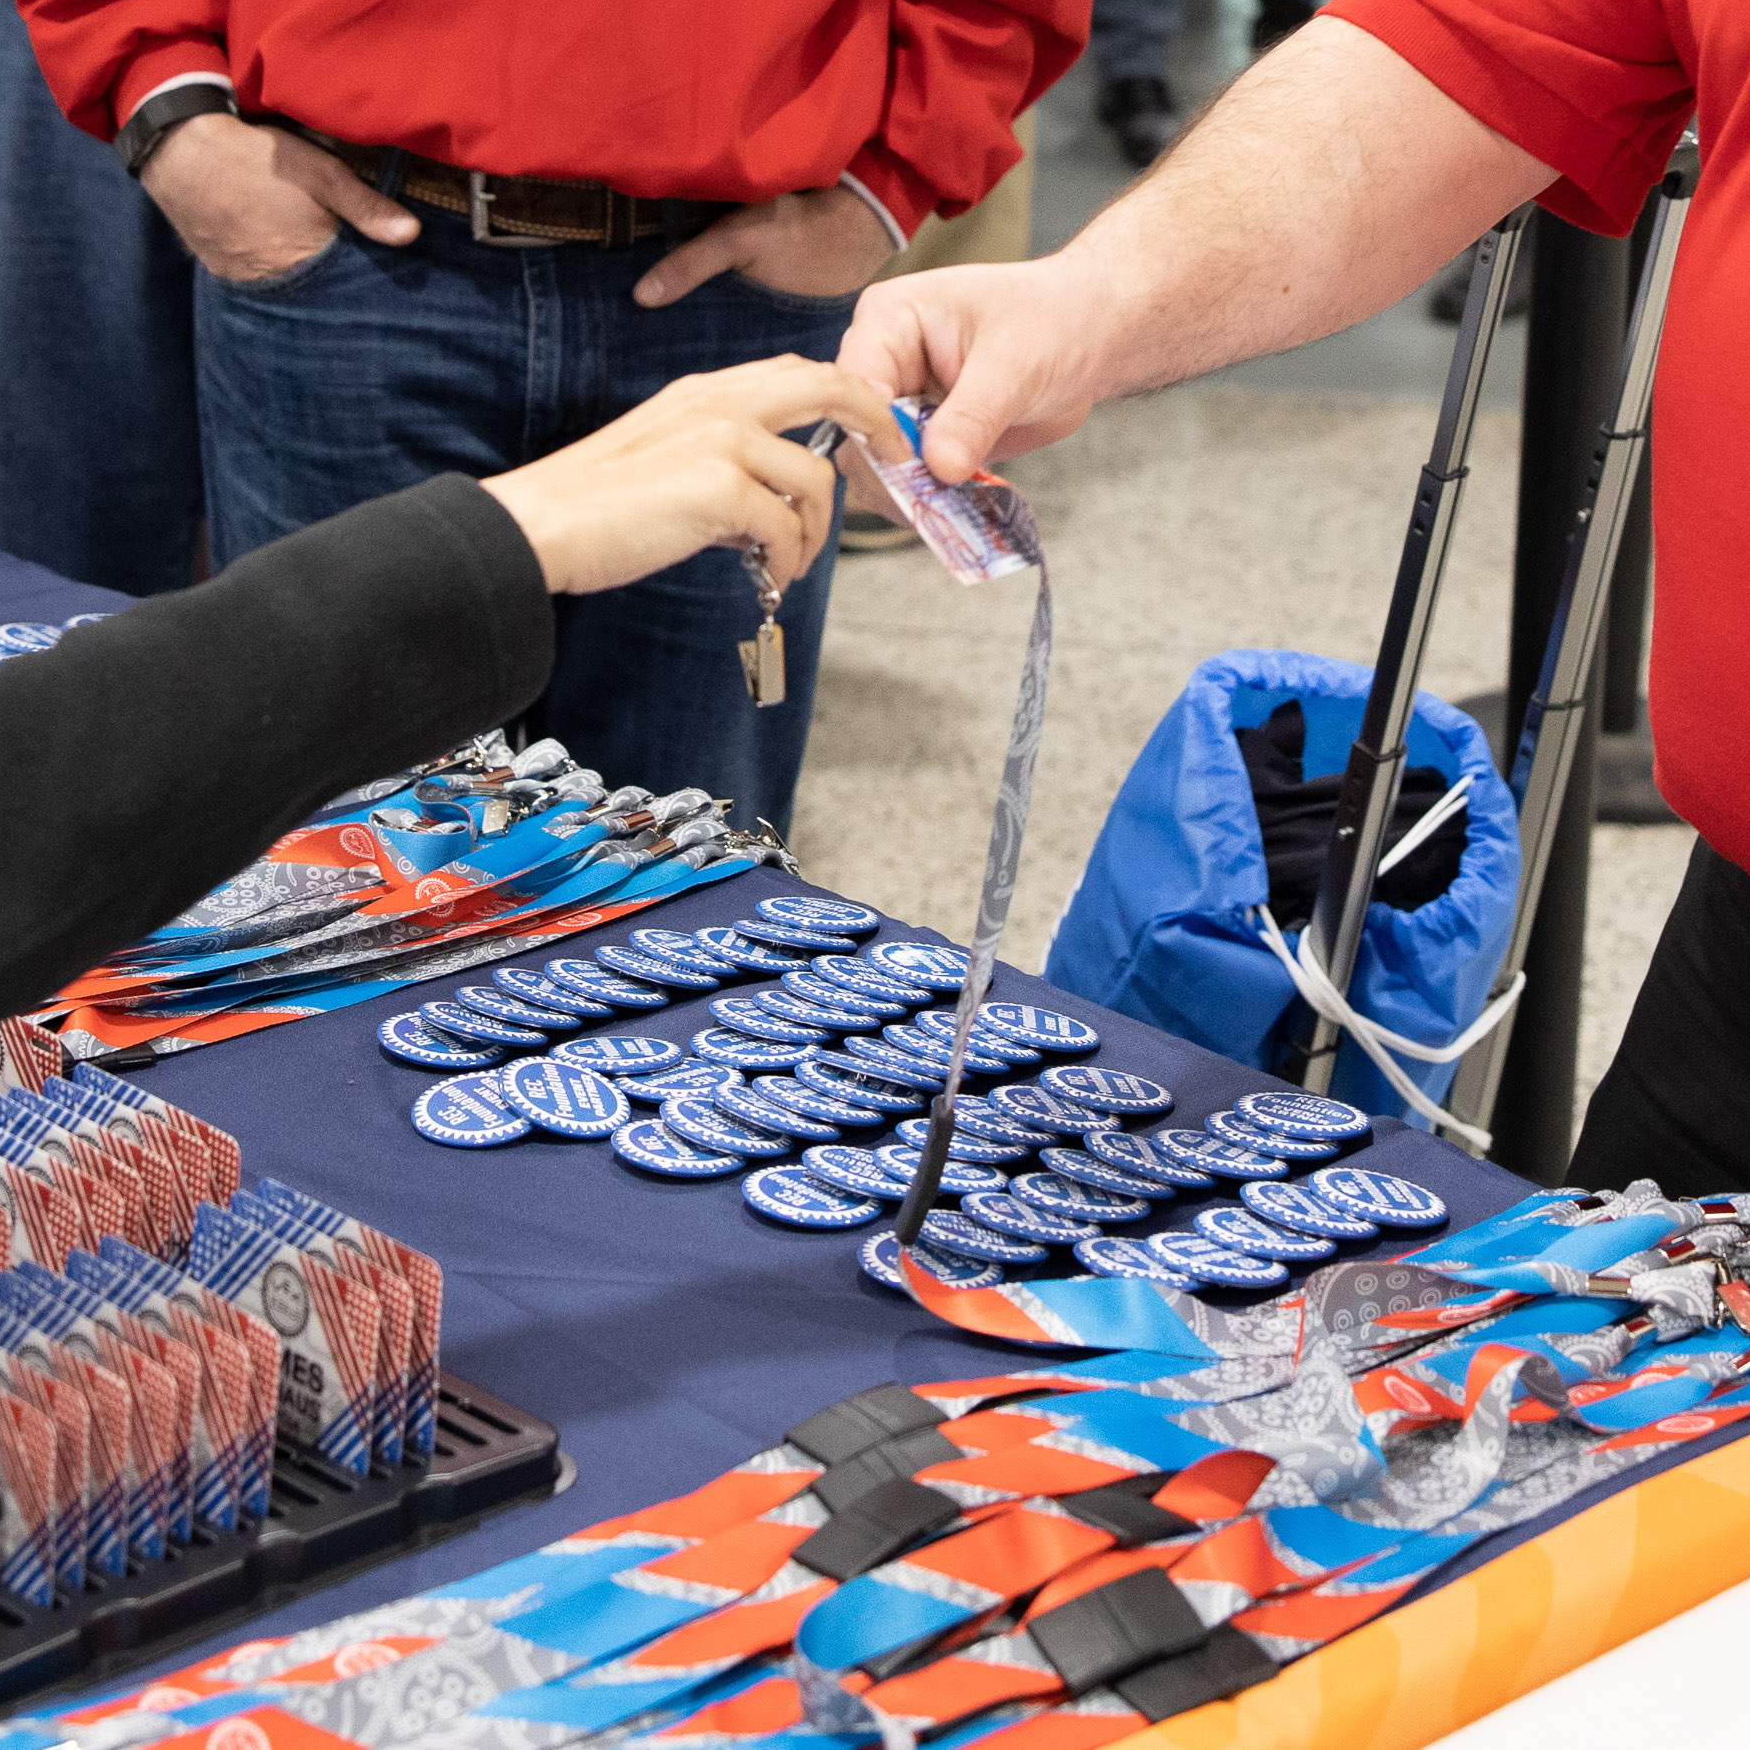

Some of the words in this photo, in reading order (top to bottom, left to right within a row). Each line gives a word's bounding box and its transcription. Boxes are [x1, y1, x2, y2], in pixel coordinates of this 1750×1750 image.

[405, 1032, 436, 1047] REC
[523, 1078, 549, 1100] REC
[540, 1062, 576, 1119] Foundation
[569, 1077, 592, 1110] EVENT
[581, 1073, 609, 1119] PARTNER
[441, 1085, 504, 1130] Foundation
[1260, 1095, 1354, 1121] Foundation
[1273, 1104, 1325, 1119] EVENT
[1295, 1095, 1330, 1108] REC
[437, 1105, 471, 1126] REC
[1257, 1105, 1330, 1126] PARTNER
[767, 1173, 849, 1212] Foundation
[775, 1190, 811, 1207] REC
